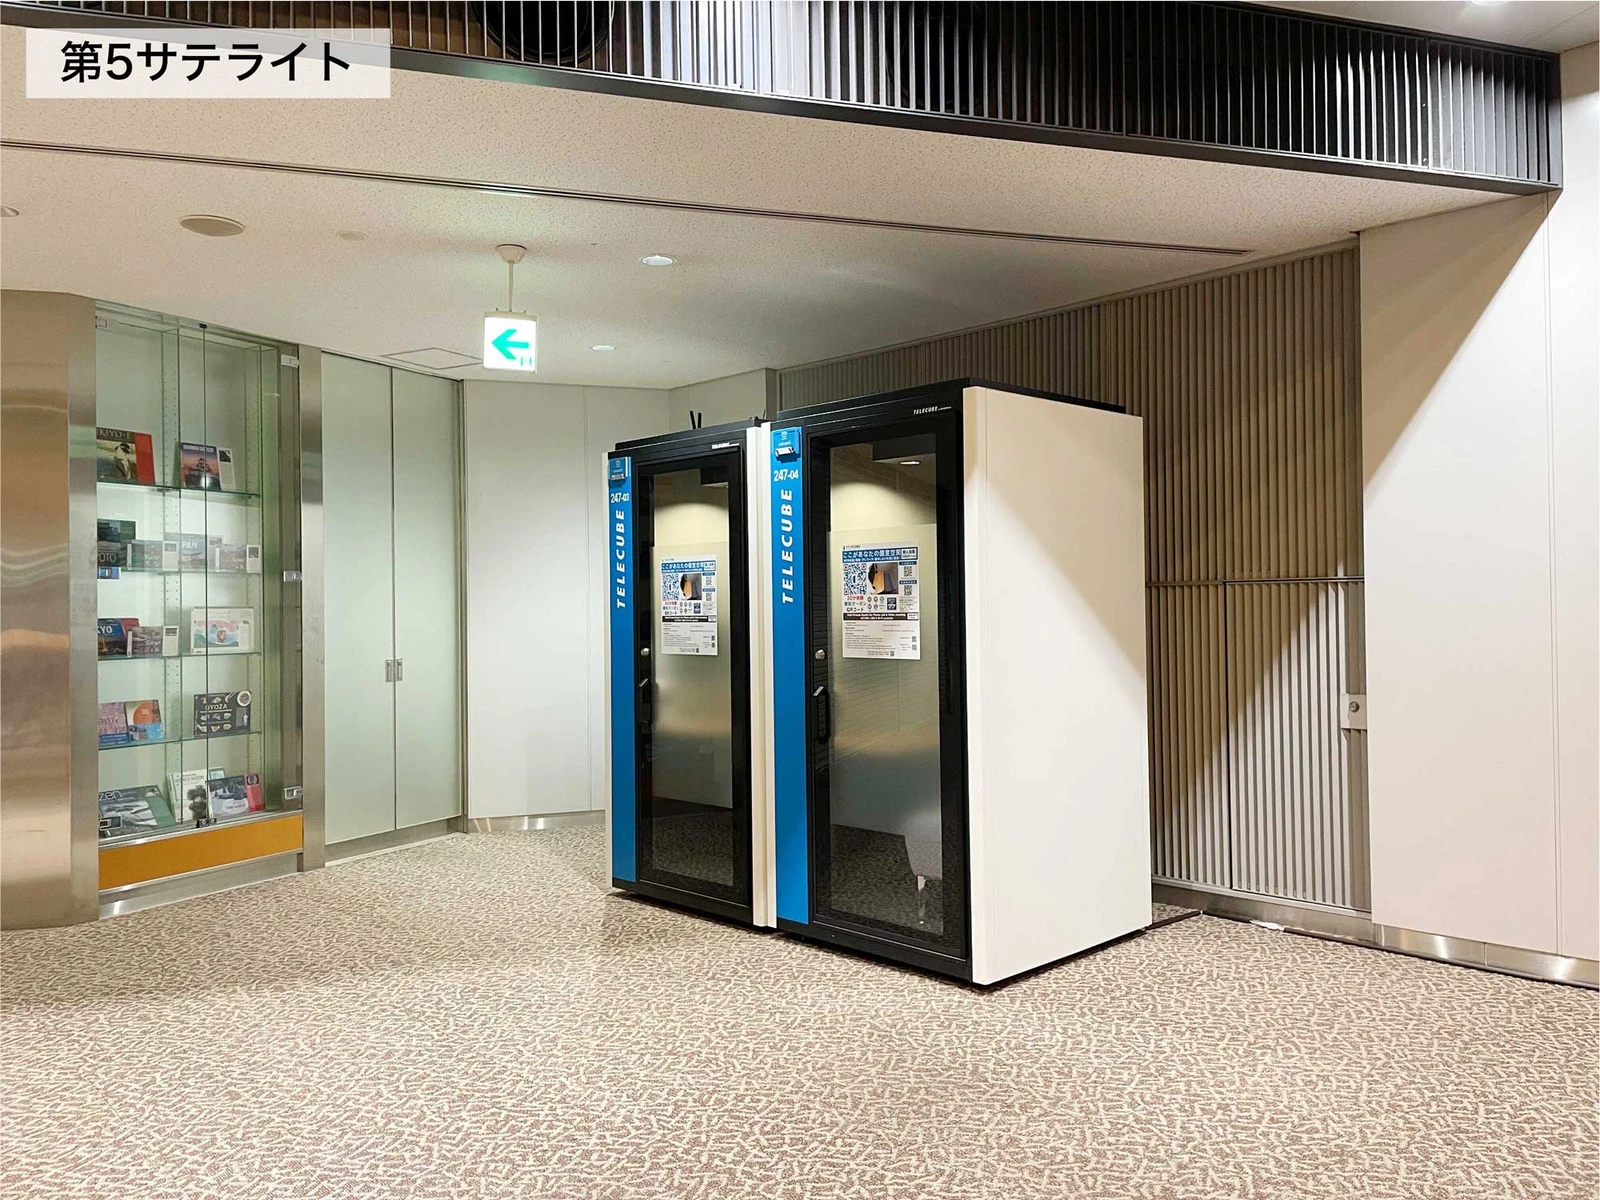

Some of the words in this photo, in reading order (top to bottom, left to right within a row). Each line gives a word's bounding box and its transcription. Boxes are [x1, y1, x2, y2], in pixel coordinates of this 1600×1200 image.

[773, 469, 799, 482] 247-04
[610, 492, 630, 504] 247-03
[780, 489, 794, 604] TELECUBE
[615, 509, 626, 609] TELECUBE
[205, 703, 228, 711] GYOZA
